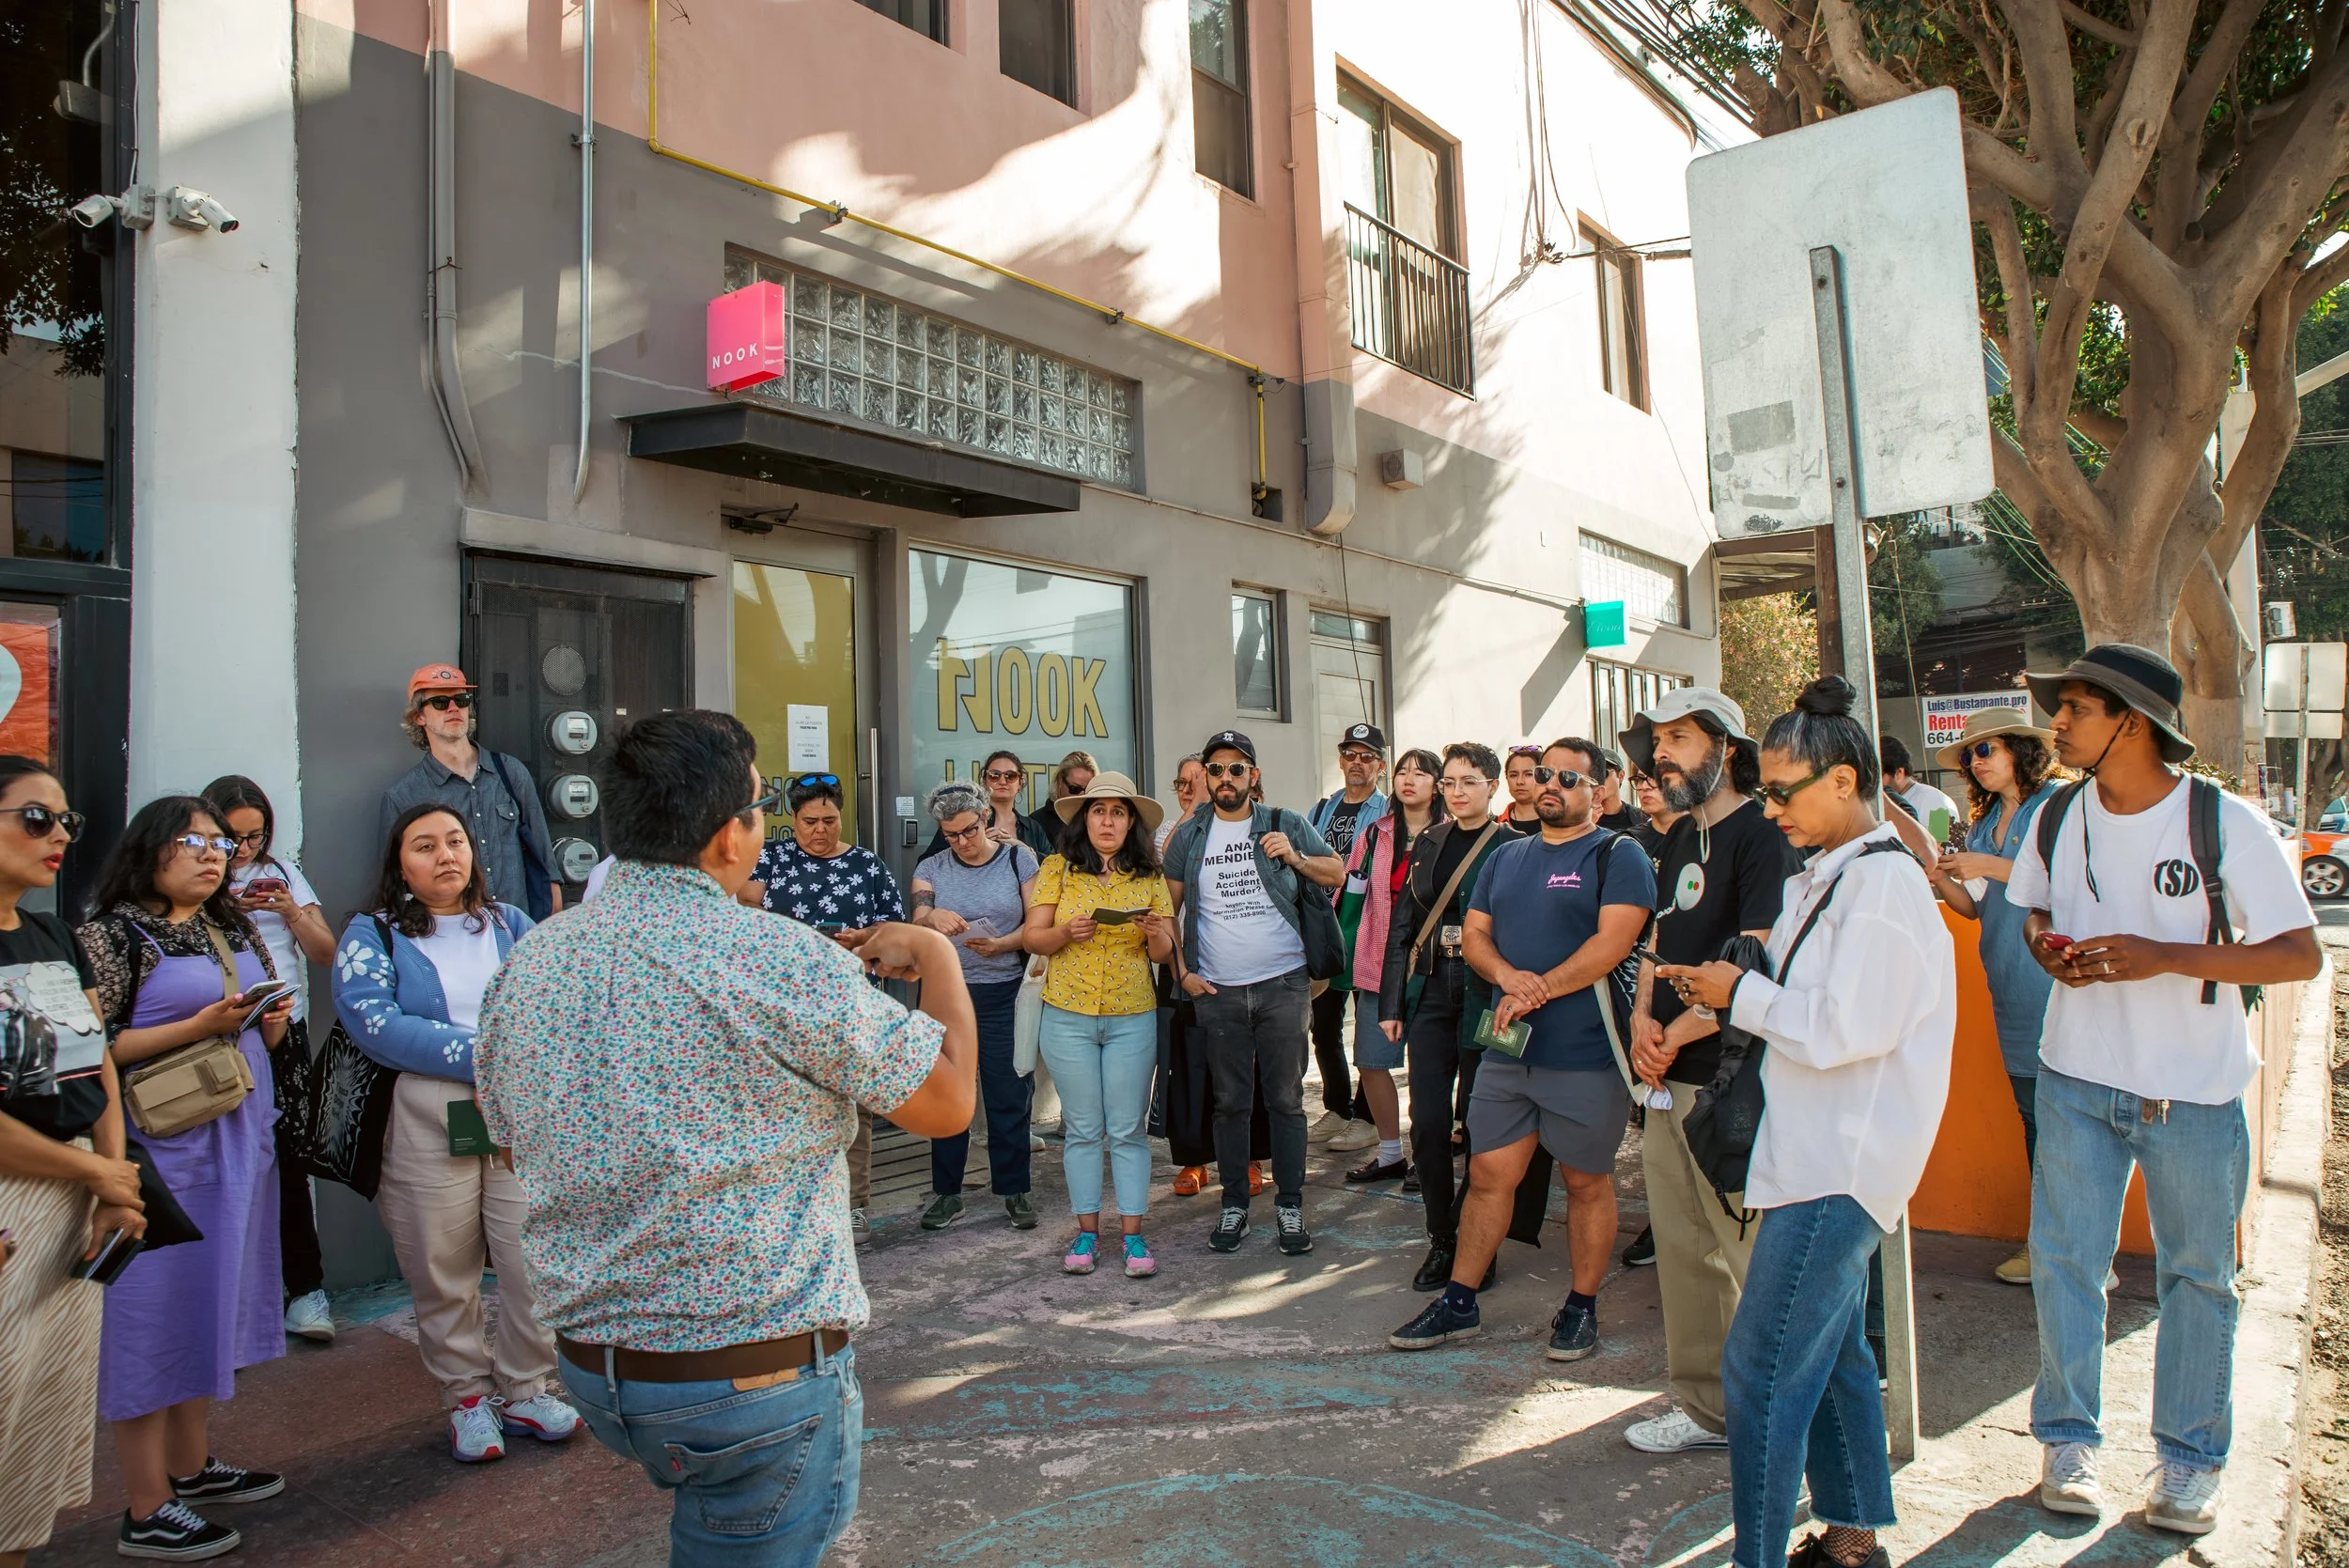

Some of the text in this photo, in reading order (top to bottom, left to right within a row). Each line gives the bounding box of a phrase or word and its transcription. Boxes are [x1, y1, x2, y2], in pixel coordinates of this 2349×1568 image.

[712, 342, 758, 369] NOOK
[937, 637, 1109, 738] NOOK
[1927, 695, 2028, 711] Luis@Bustamante.pro
[1224, 842, 1252, 853] ANA
[1205, 851, 1254, 866] MENDIE
[1218, 868, 1259, 880] Suicide
[2154, 859, 2200, 897] TSD
[1221, 886, 1262, 898] Murder?
[1213, 908, 1245, 916] nformation
